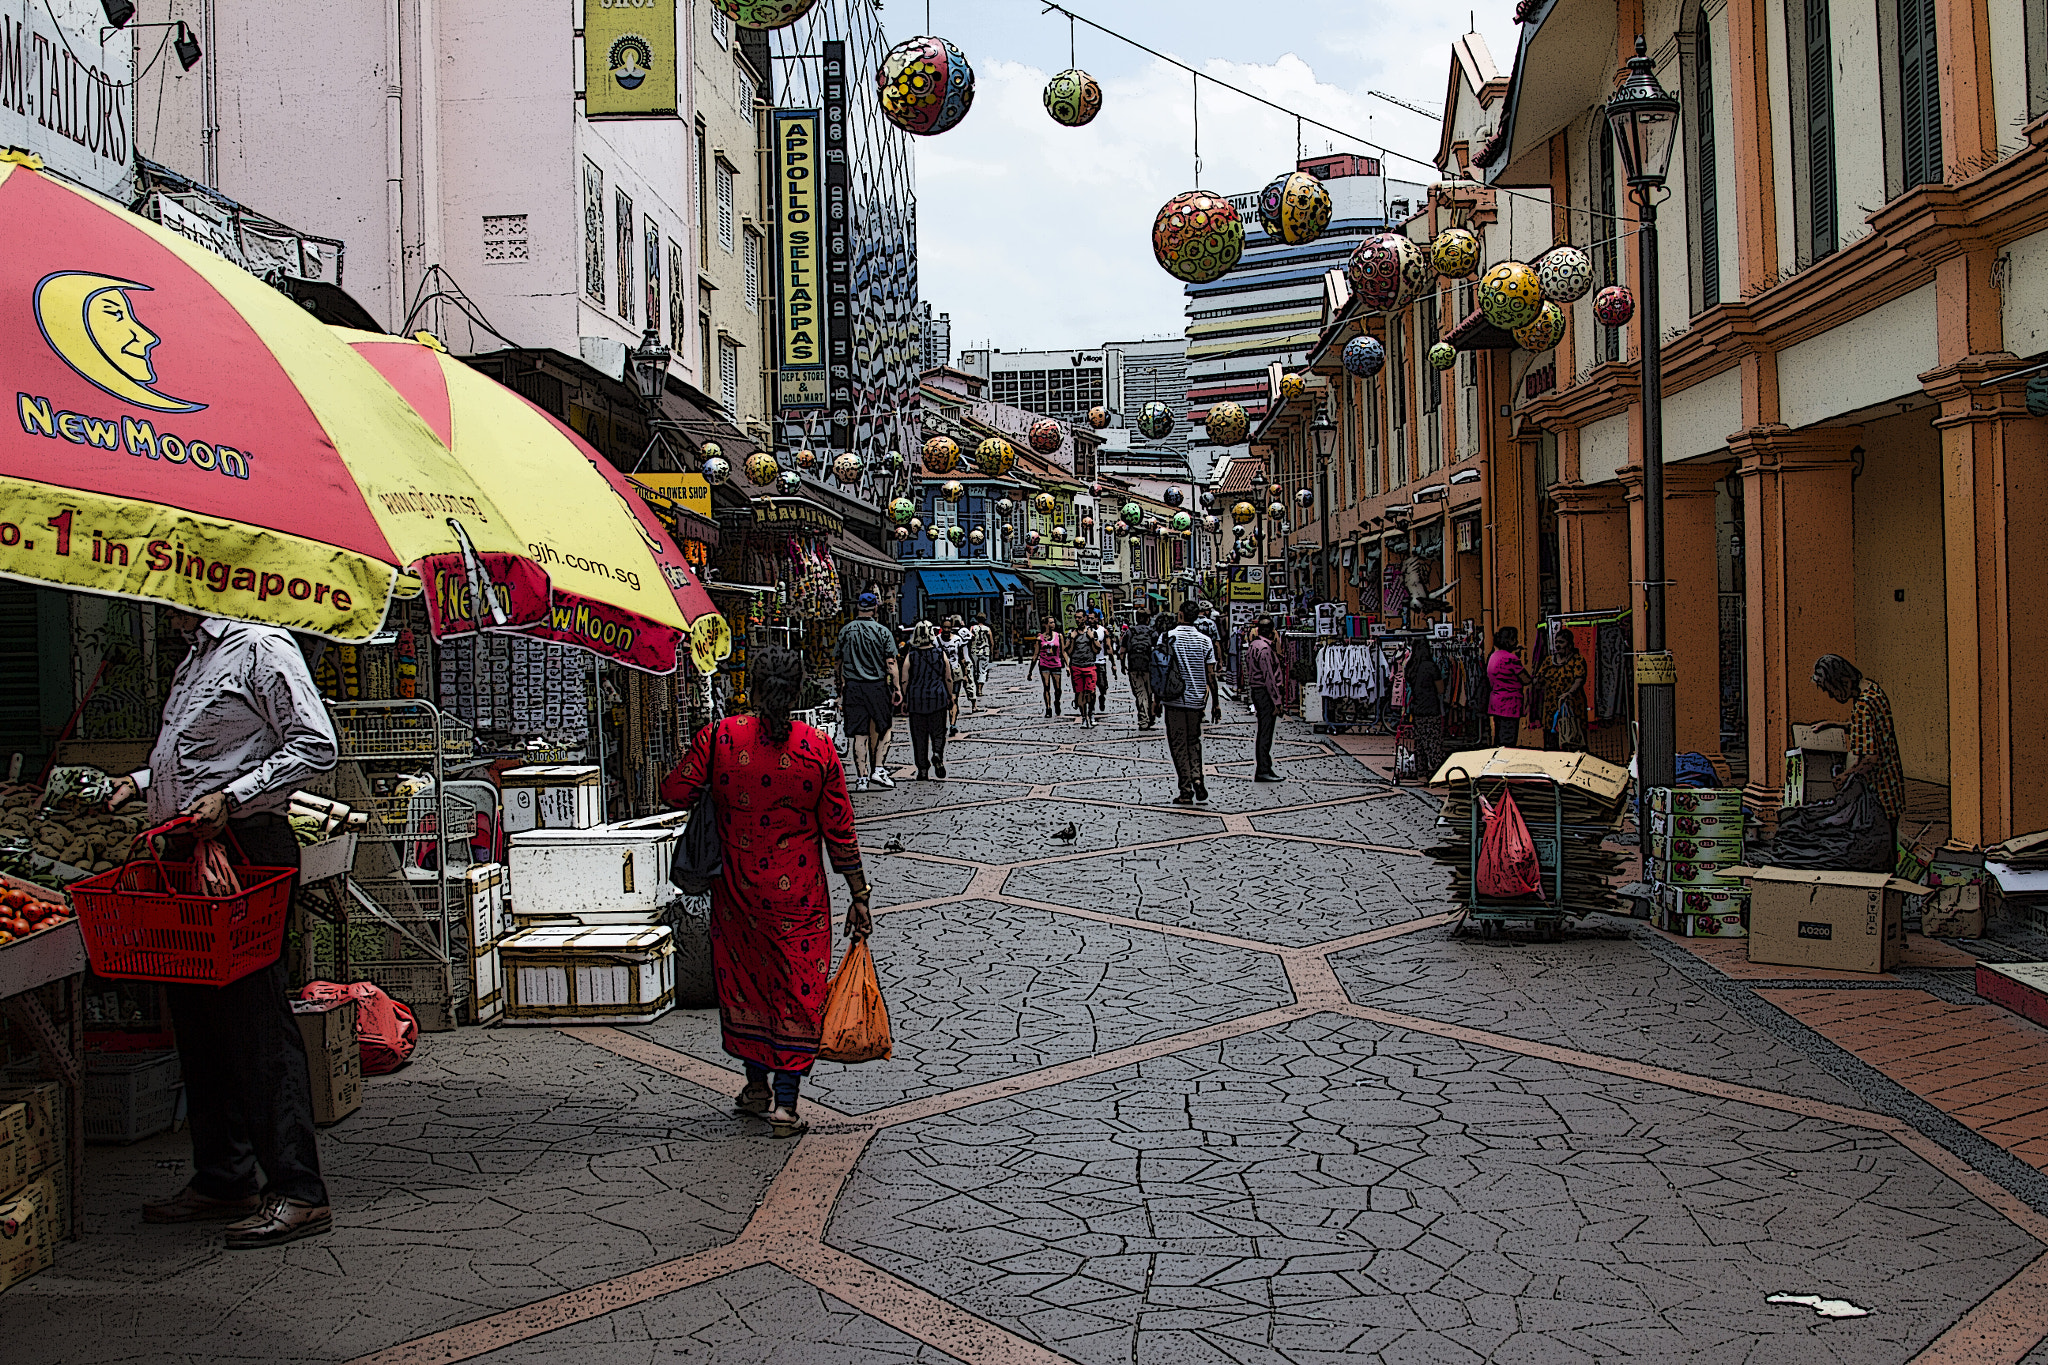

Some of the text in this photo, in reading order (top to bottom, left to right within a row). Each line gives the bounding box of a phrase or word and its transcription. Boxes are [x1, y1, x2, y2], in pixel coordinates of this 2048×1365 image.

[32, 31, 126, 166] TAILORS
[785, 123, 814, 360] APPOLLO SELLAPPAS
[799, 382, 808, 392] &
[802, 371, 824, 381] STORE
[783, 393, 824, 403] GOLD MART
[688, 486, 708, 499] SHOP
[91, 528, 129, 567] in
[146, 540, 353, 612] Singapore
[528, 542, 641, 591] gjh.com.sg
